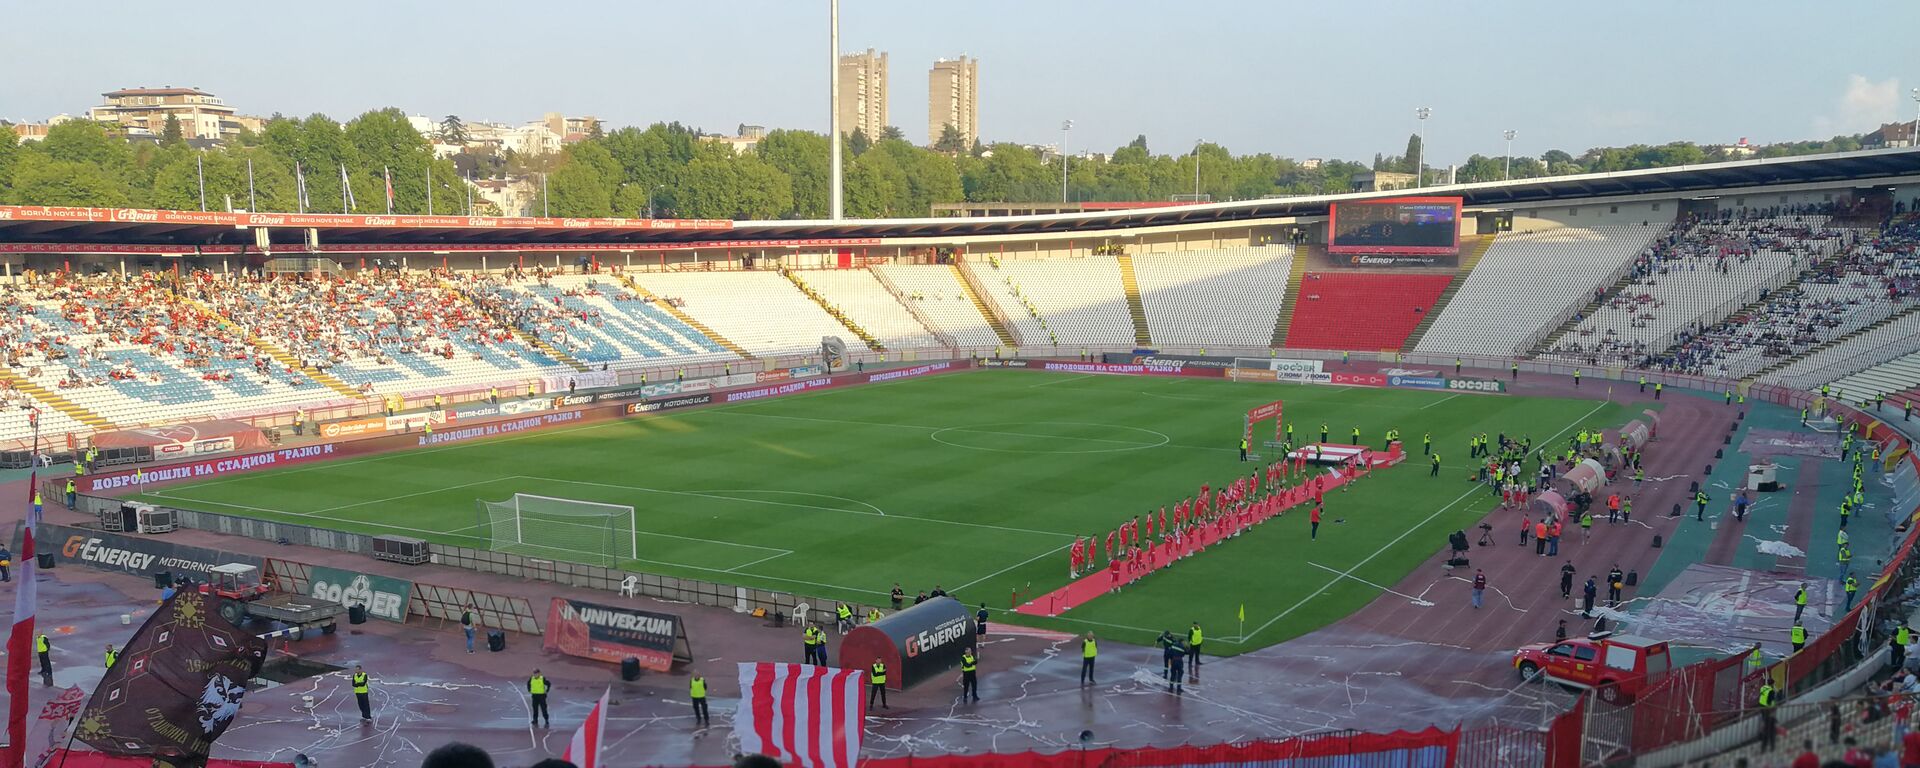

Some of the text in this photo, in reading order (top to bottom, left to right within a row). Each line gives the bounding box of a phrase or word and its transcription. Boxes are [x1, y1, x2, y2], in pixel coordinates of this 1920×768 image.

[1450, 380, 1499, 391] SOCCER
[555, 395, 594, 406] G-ENERGY
[628, 402, 661, 413] G-ENERGY
[419, 430, 484, 445] ДБРОДОШЛИ
[486, 425, 499, 434] НА
[501, 417, 541, 432] СТАДИОН
[92, 466, 191, 491] ДОБРОДОШЛИ
[195, 463, 214, 476] НА
[217, 453, 275, 472] СТАДИОН
[62, 535, 155, 571] G-ENERGY
[580, 607, 672, 636] UNIVERZUM
[905, 620, 967, 658] G-ENERGY
